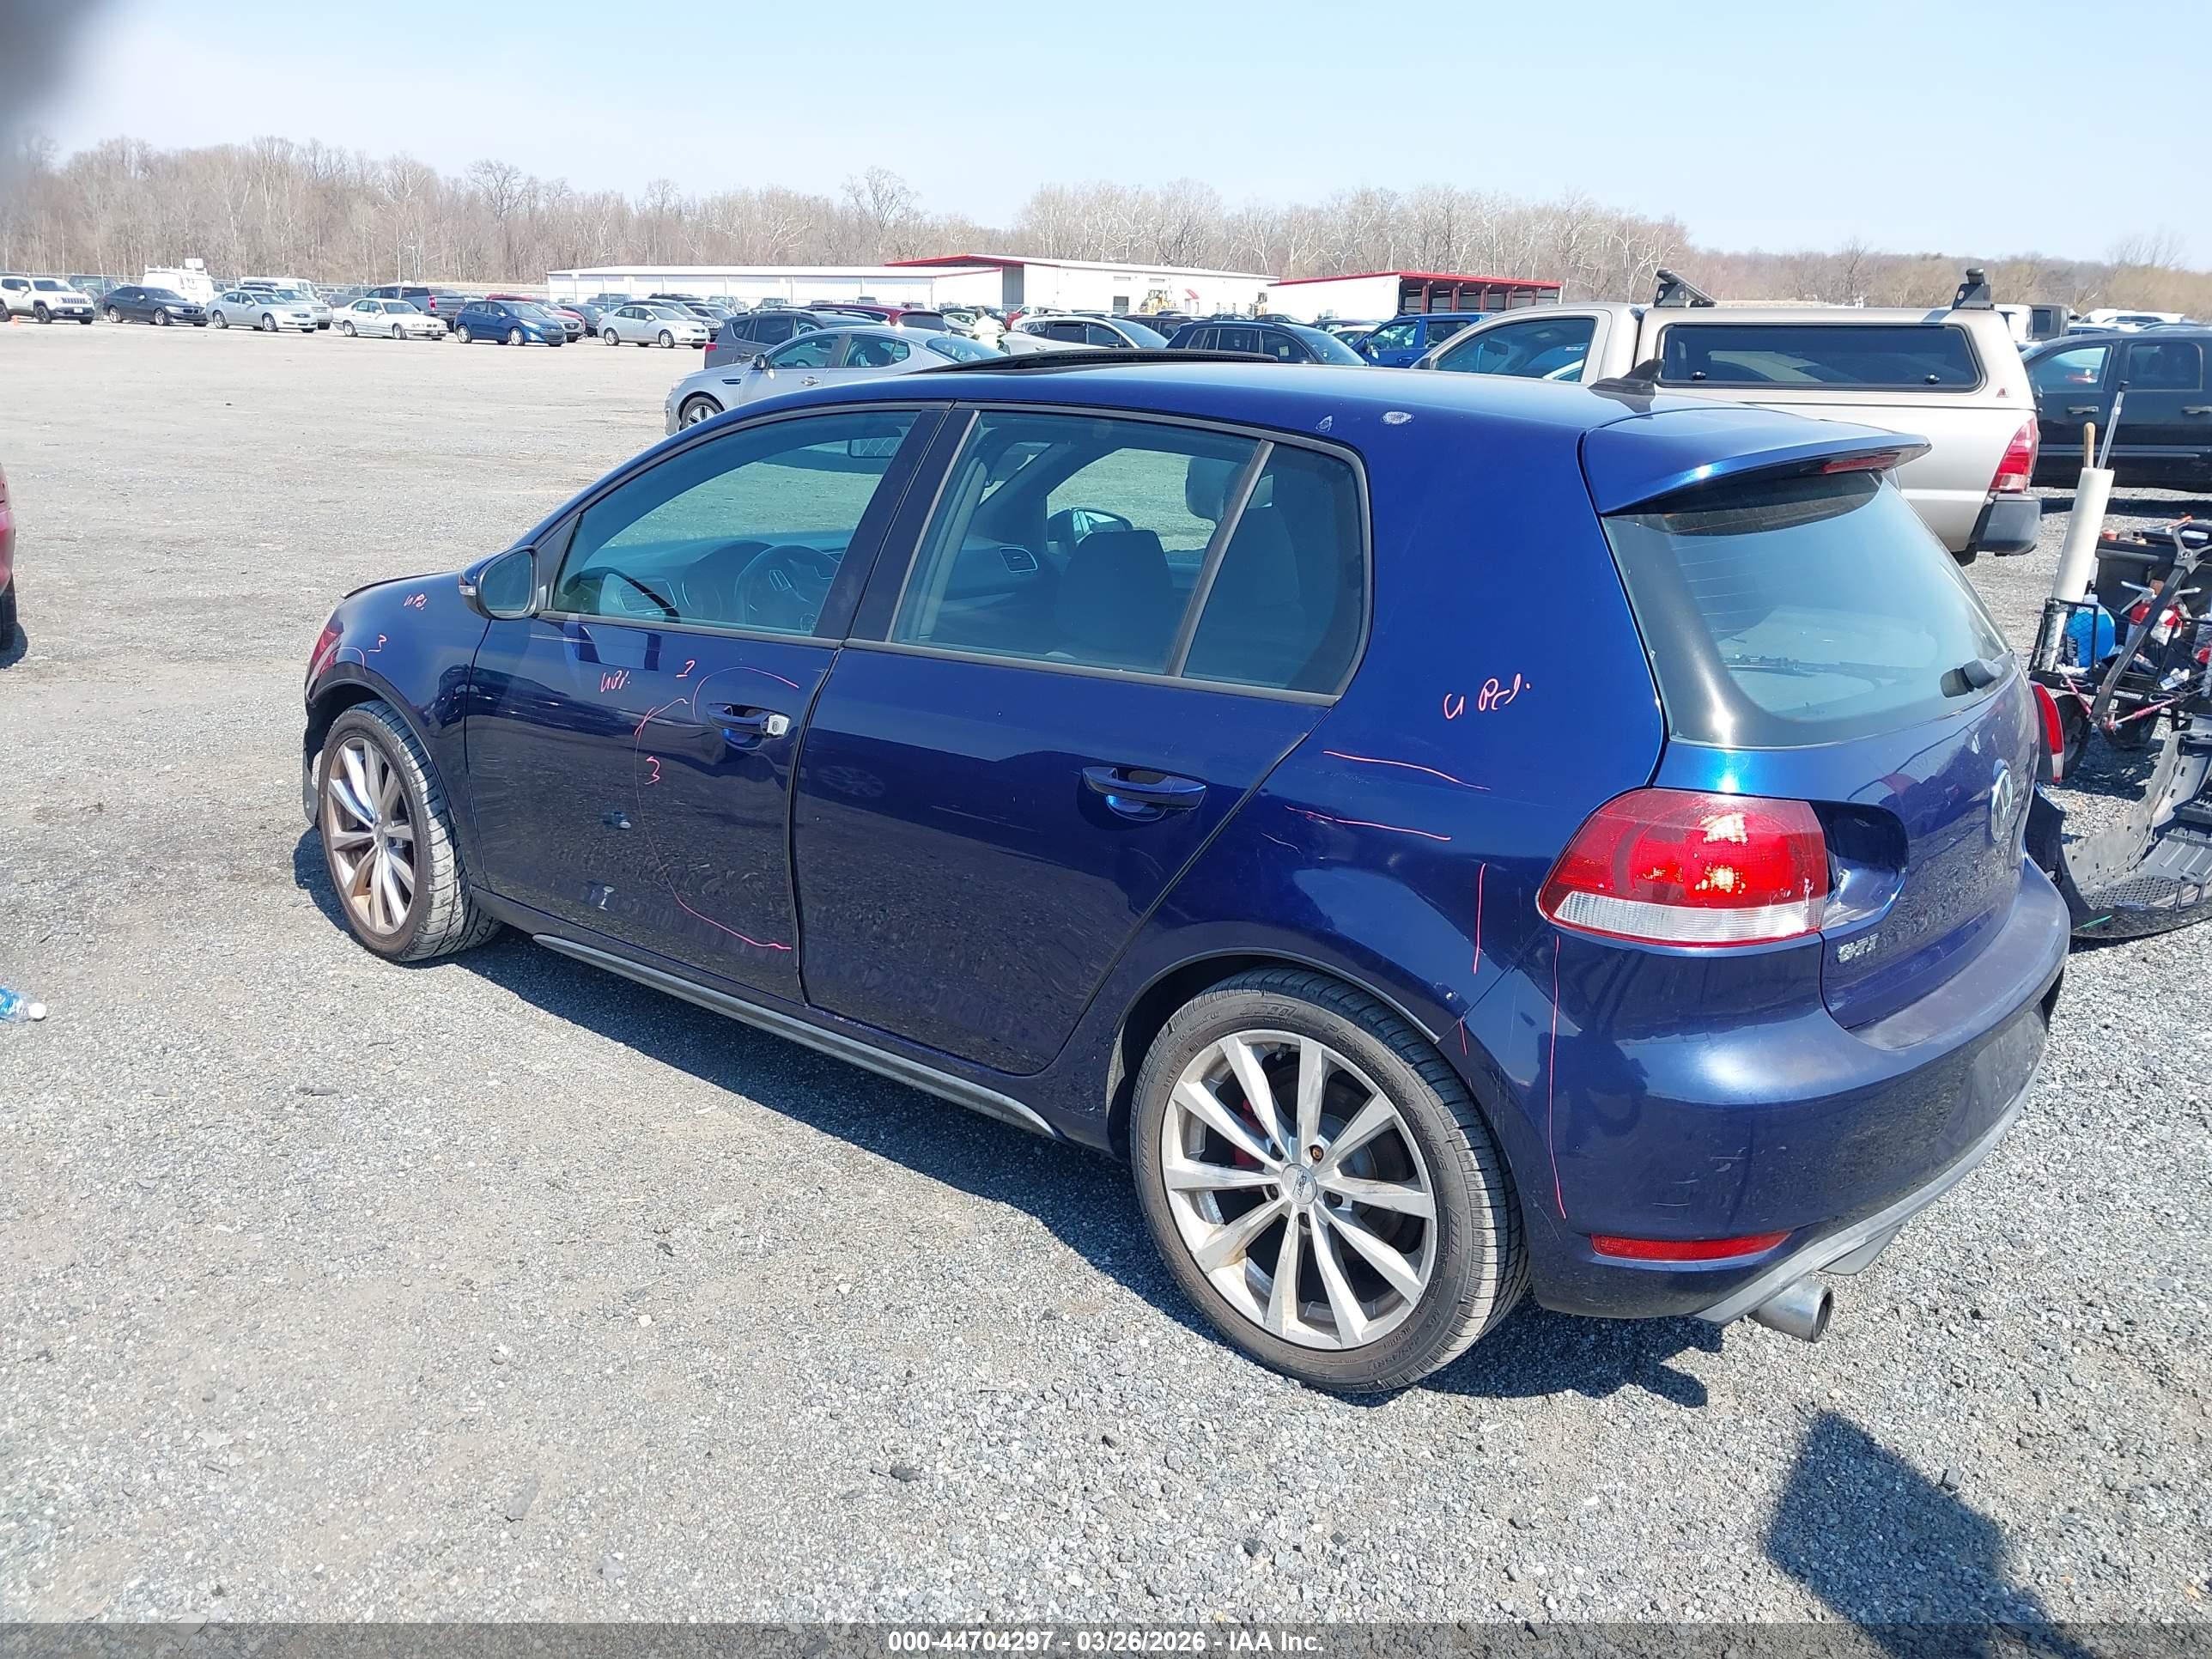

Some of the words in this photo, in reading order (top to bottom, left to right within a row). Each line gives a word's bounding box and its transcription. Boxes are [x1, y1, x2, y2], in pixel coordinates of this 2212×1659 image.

[644, 756, 660, 785] 3
[1838, 933, 1879, 963] GTI
[1322, 1018, 1449, 1171] PERFORMANCE
